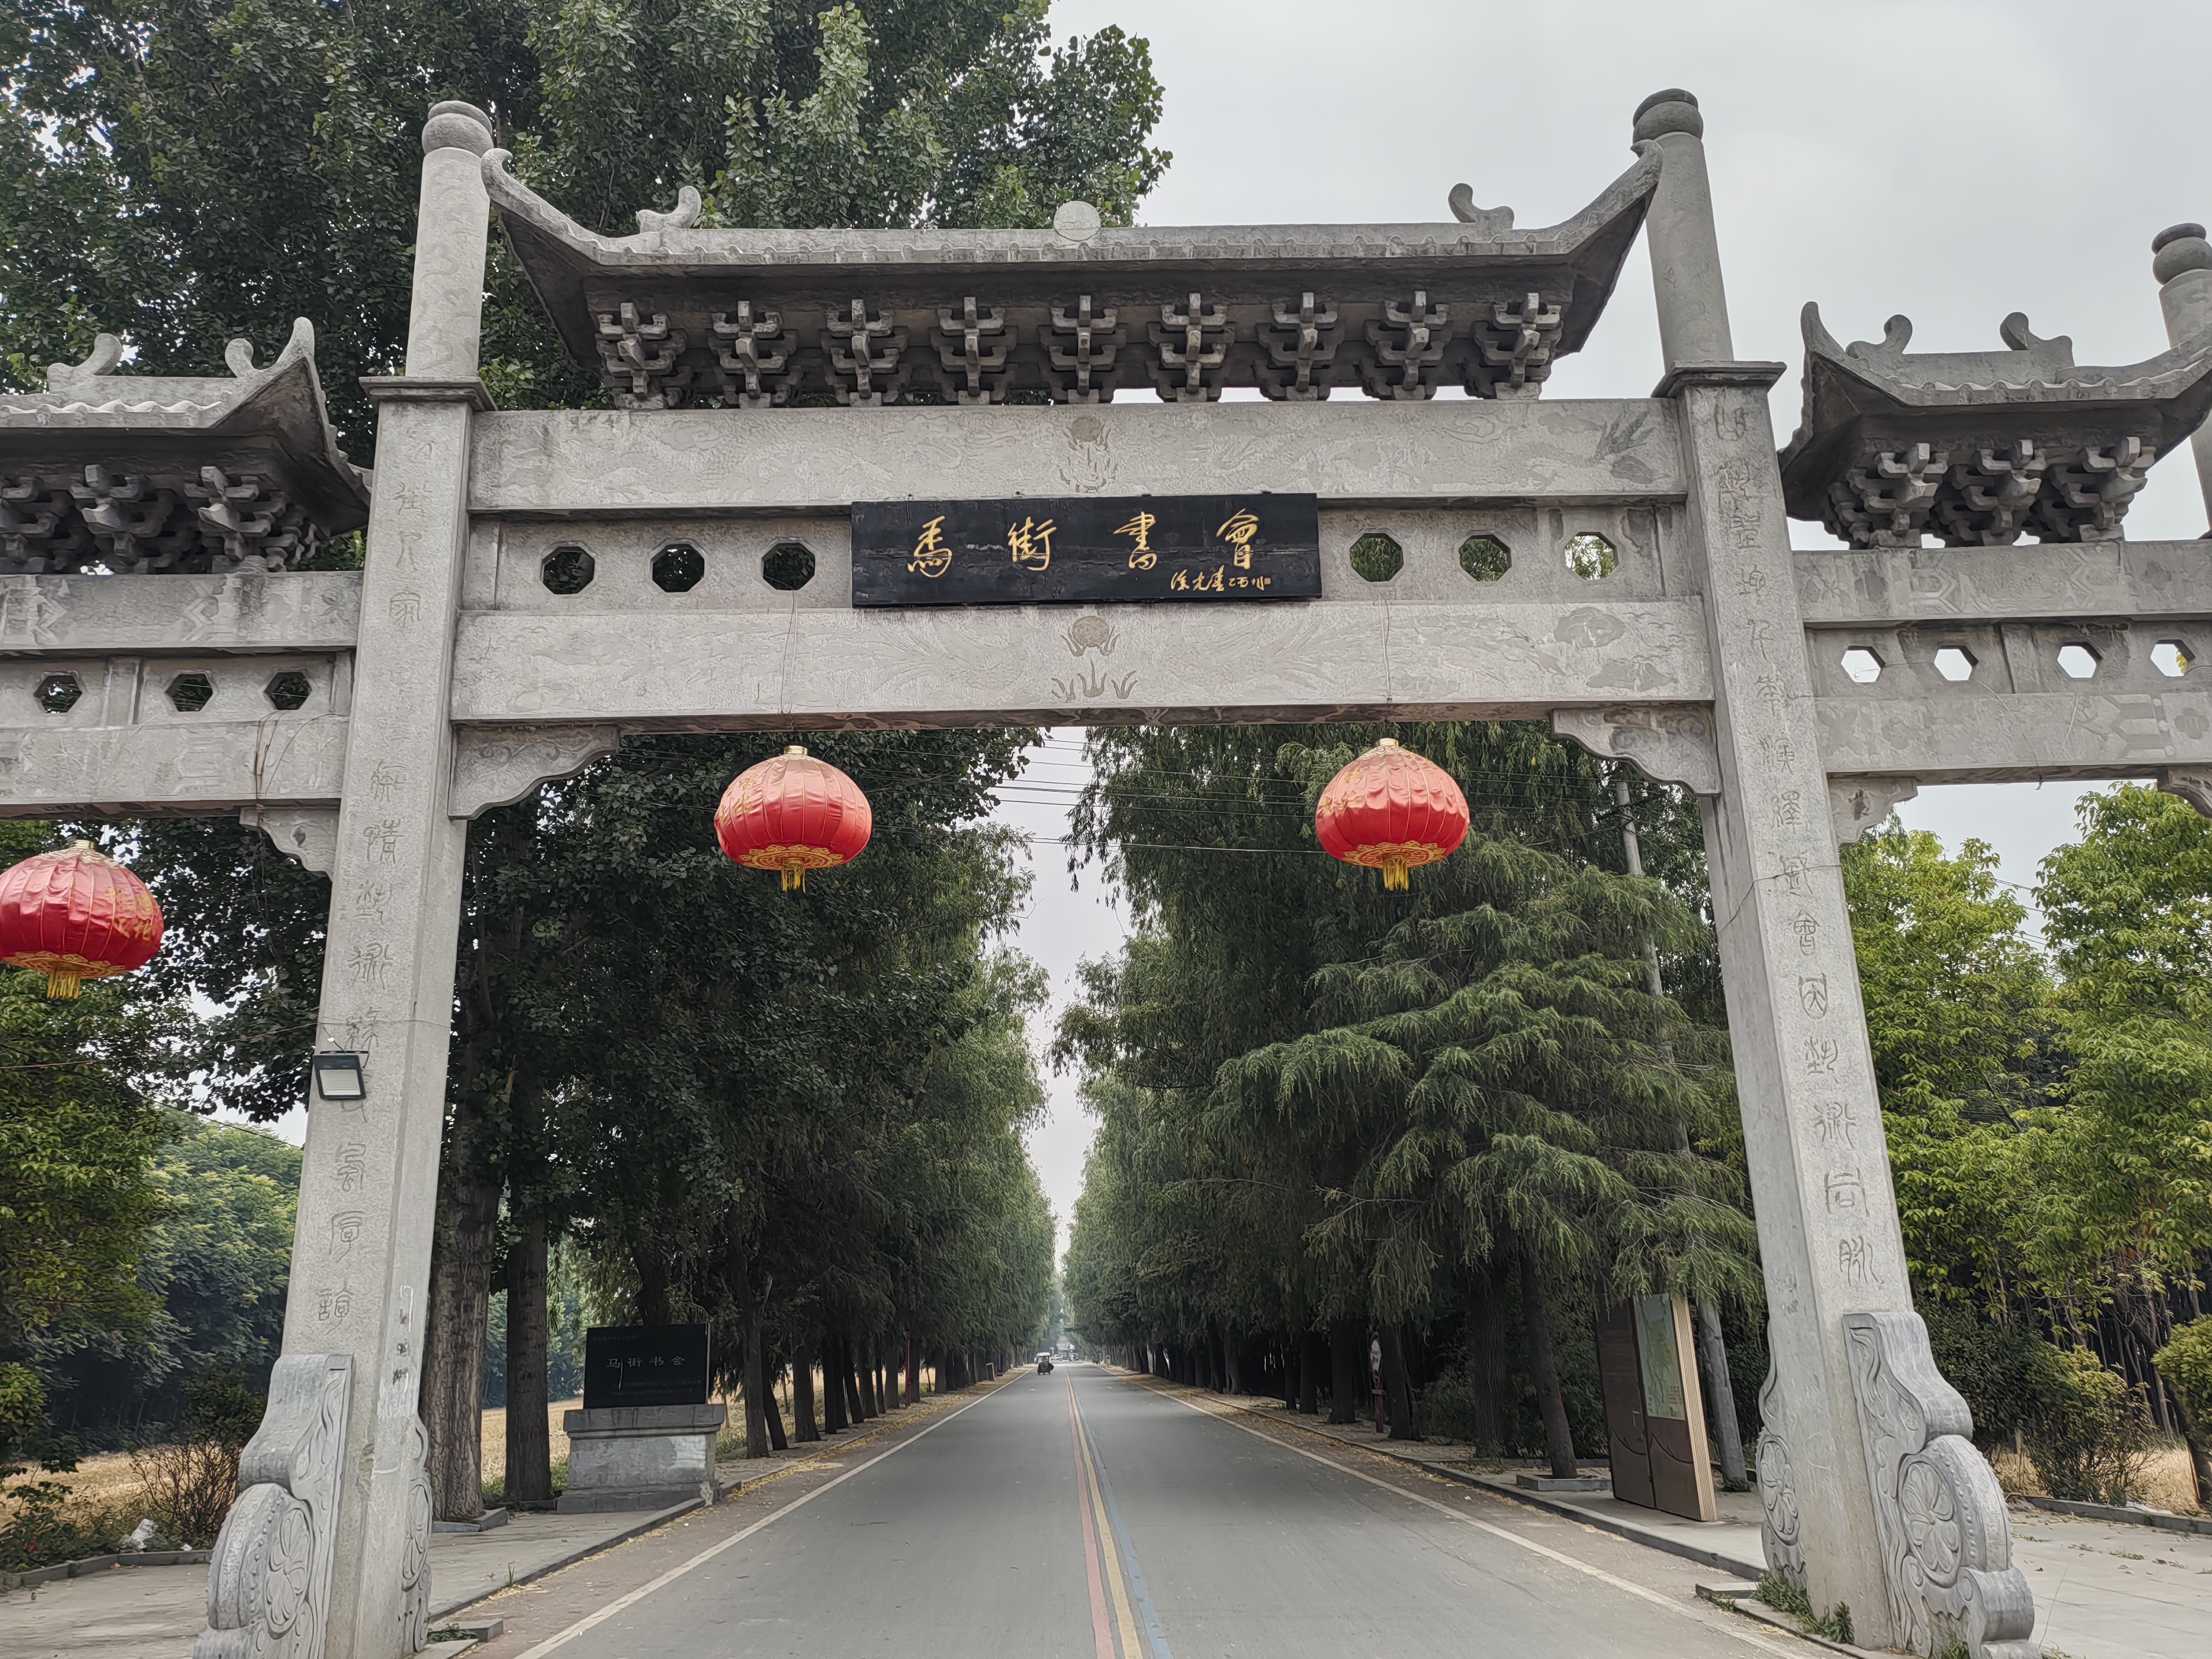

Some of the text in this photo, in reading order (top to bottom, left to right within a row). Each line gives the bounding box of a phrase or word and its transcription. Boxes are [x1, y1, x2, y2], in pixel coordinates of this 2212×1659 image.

[907, 508, 1260, 577] 馬街書會
[606, 1355, 686, 1368] 马街书会
